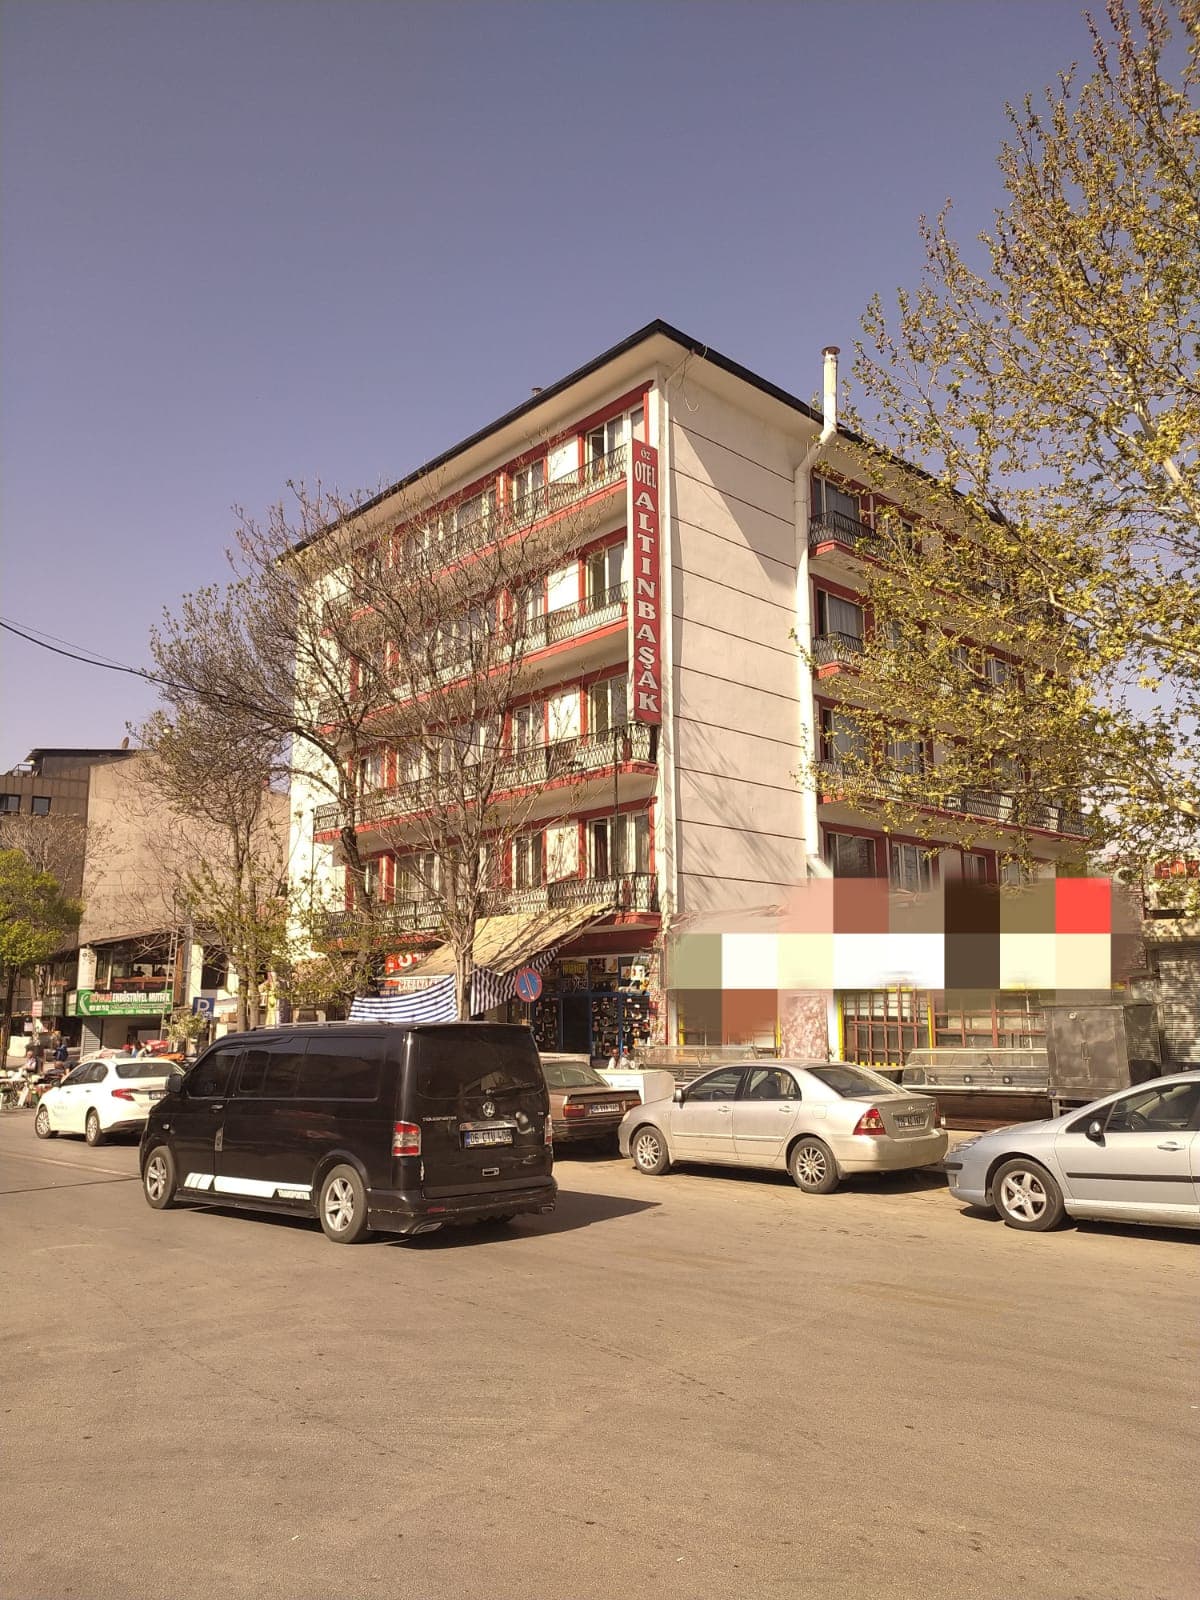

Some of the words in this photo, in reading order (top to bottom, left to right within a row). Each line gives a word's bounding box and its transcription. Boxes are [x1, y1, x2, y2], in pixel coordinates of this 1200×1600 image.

[635, 461, 656, 488] OTEL
[635, 491, 659, 713] ALTINBAŞAK
[470, 1132, 480, 1144] 06
